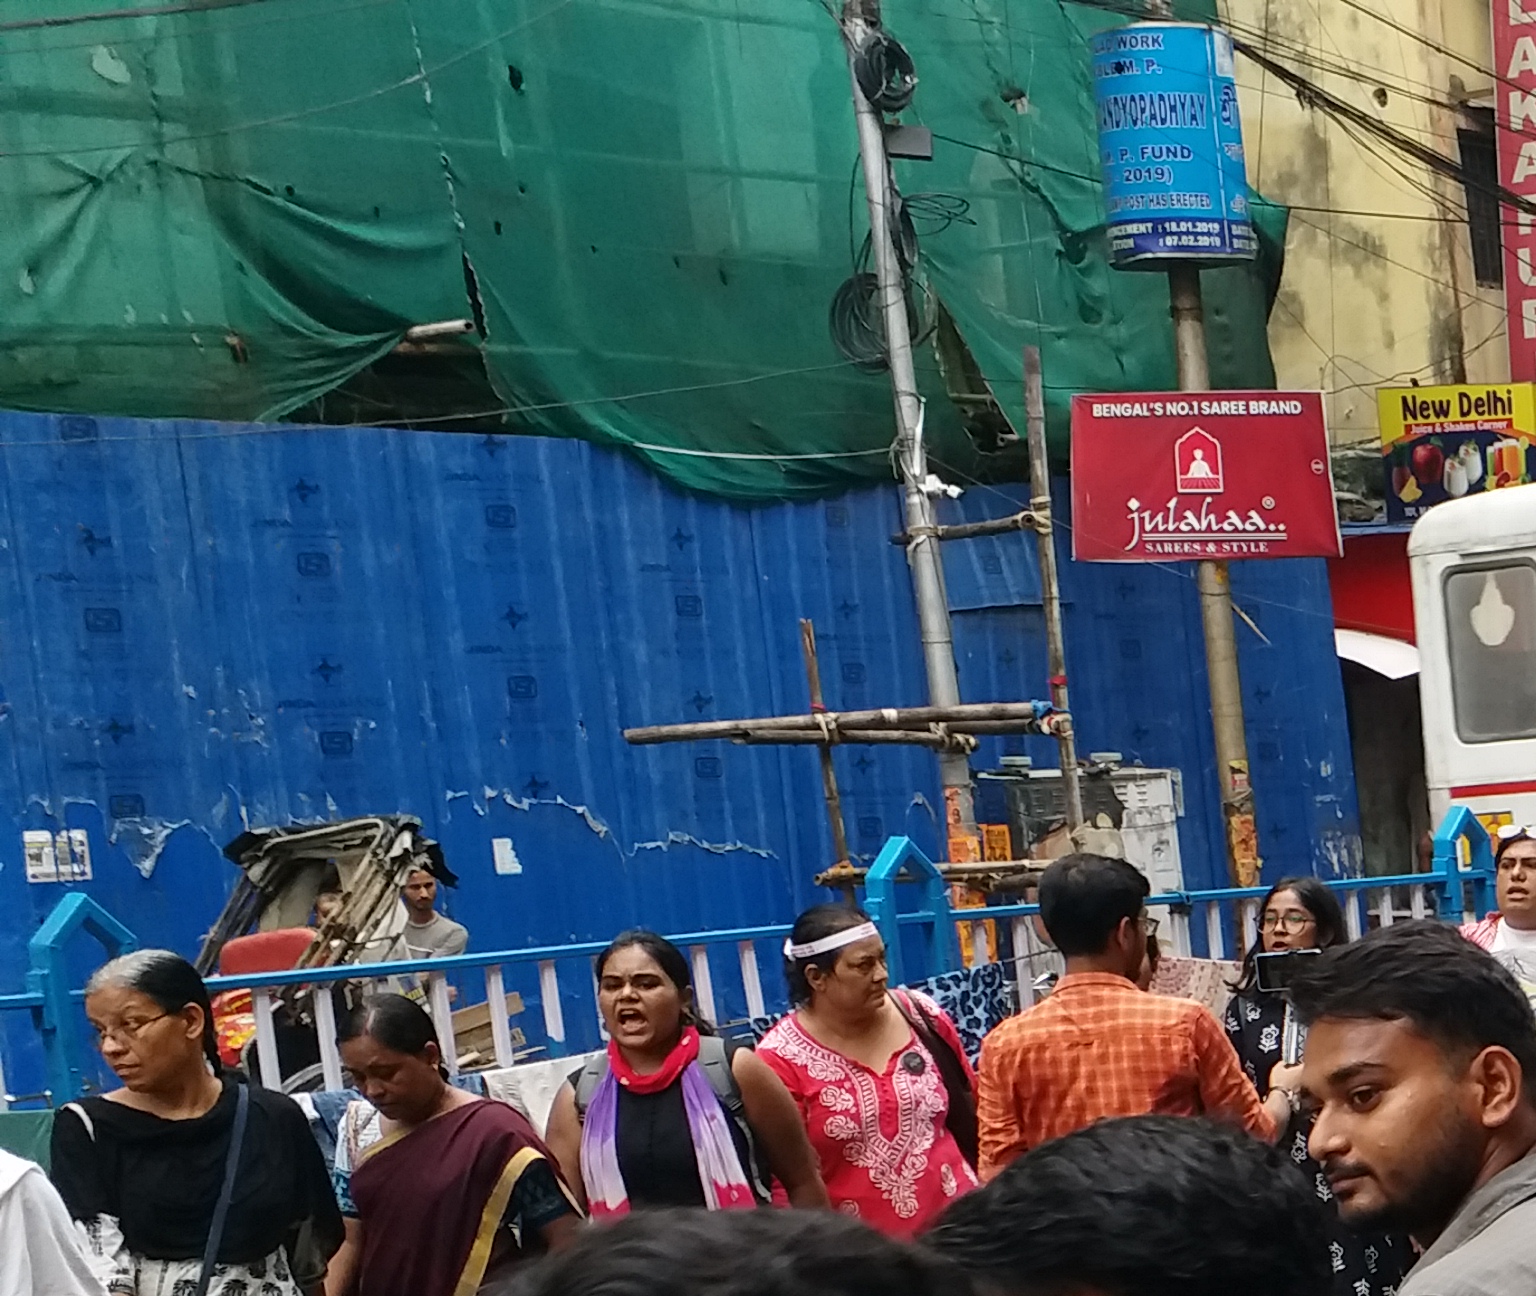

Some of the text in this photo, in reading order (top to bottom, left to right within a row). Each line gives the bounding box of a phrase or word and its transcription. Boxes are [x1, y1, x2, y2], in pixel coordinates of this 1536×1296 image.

[1117, 34, 1162, 50] WORK
[1140, 145, 1192, 161] FUND
[1092, 401, 1302, 417] BENGAL'S NO.1 SAREE BRAND
[1401, 388, 1513, 421] New Delhi
[1145, 541, 1269, 553] SAREES & STYLE
